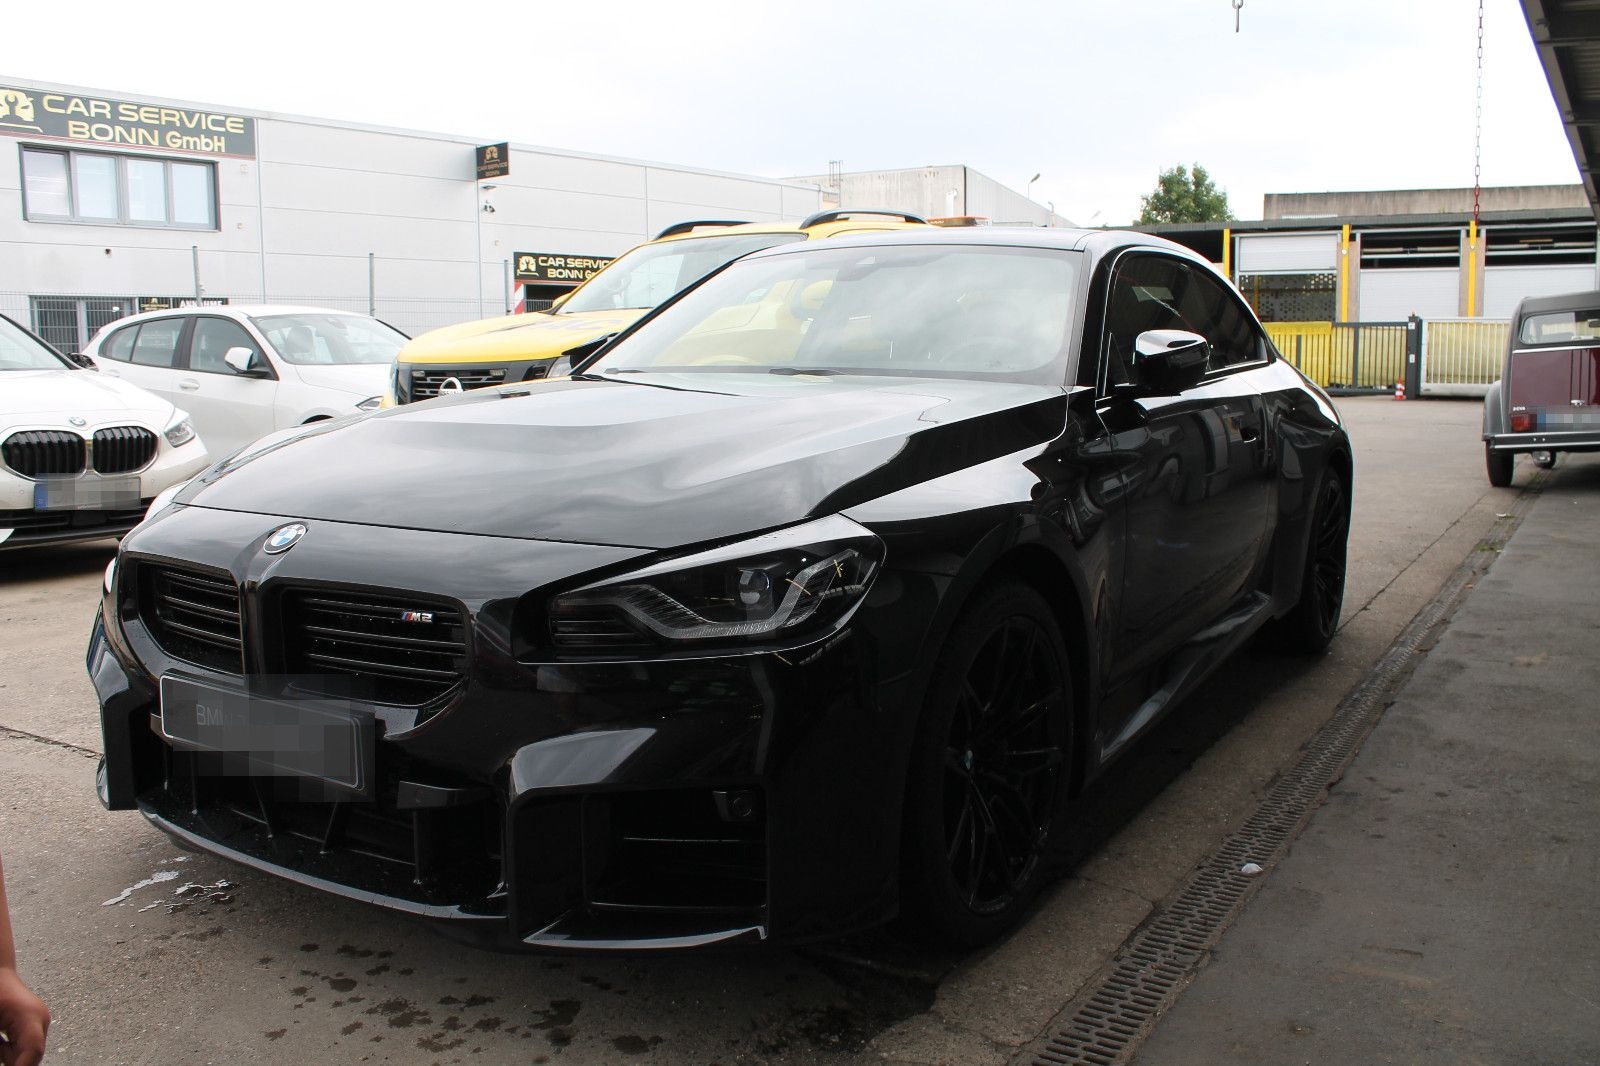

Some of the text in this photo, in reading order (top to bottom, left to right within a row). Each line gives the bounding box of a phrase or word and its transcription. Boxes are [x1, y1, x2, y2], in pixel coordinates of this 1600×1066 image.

[42, 94, 245, 134] CAR SERVICE
[67, 120, 226, 153] BONN GmbH
[538, 256, 610, 269] CAR SERVIC
[547, 268, 583, 279] BONN
[407, 611, 433, 623] M2
